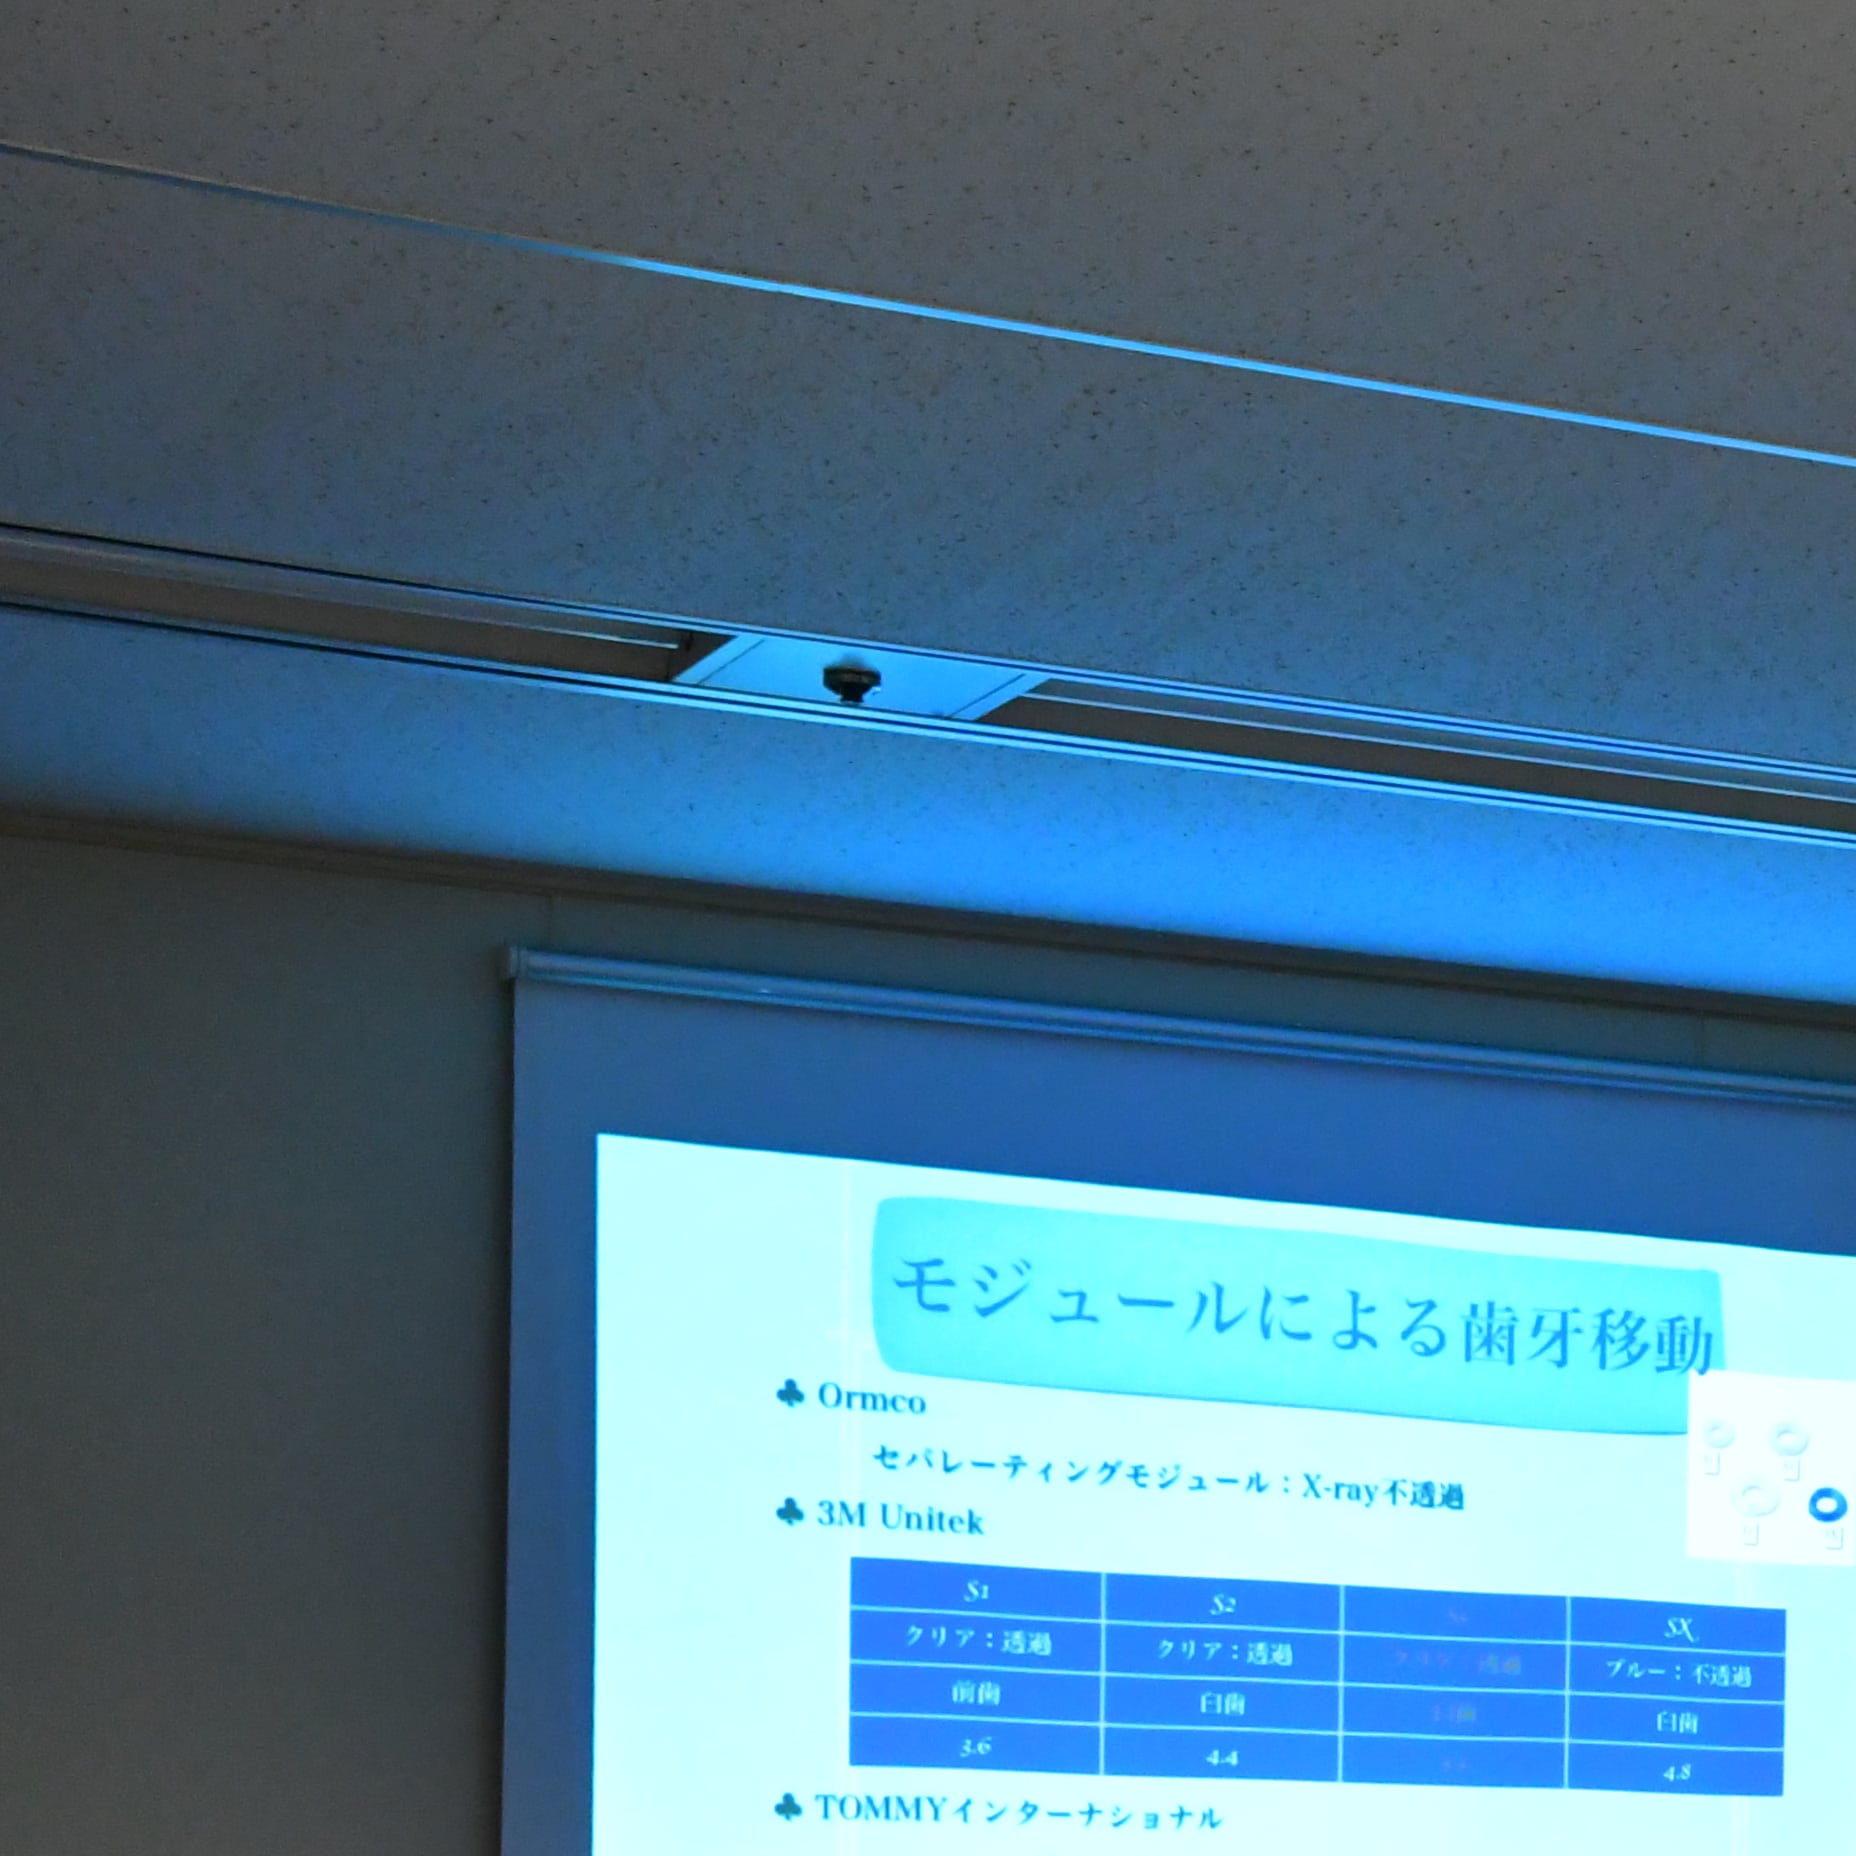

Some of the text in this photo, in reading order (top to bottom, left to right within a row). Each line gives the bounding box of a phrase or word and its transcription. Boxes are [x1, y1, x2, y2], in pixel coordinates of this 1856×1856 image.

[893, 1257, 1714, 1376] モジュールによる歯牙移動
[818, 1382, 926, 1416] Ormco
[818, 1501, 985, 1537] 3M Unitek
[815, 1793, 1223, 1830] TOMMYインターナショナル
